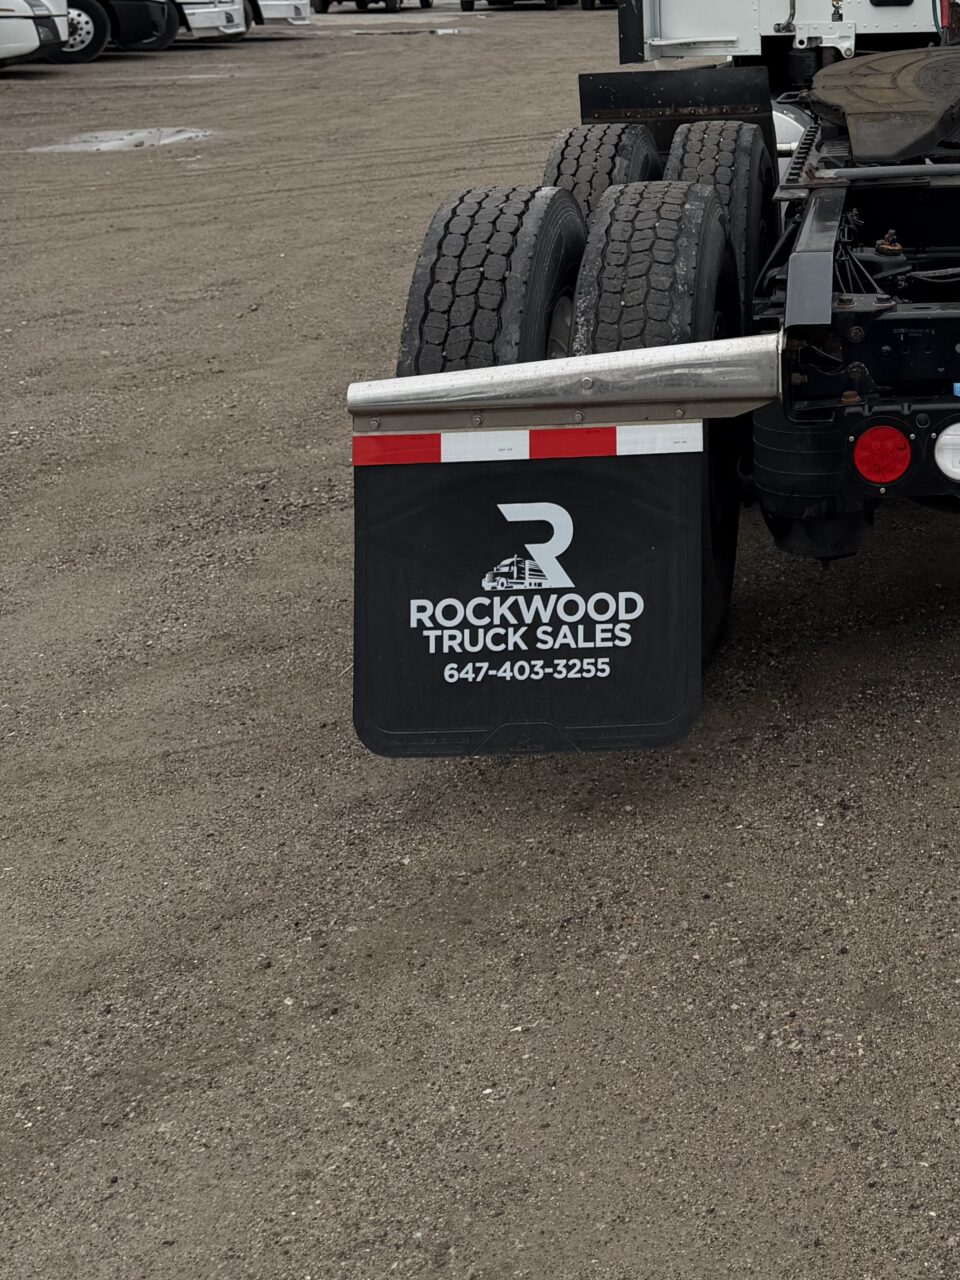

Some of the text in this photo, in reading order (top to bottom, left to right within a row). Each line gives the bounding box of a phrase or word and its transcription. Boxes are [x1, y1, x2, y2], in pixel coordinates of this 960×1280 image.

[409, 591, 645, 628] ROCKWOOD
[422, 622, 632, 654] TRUCK SALES
[443, 657, 611, 683] 647-403-3255
